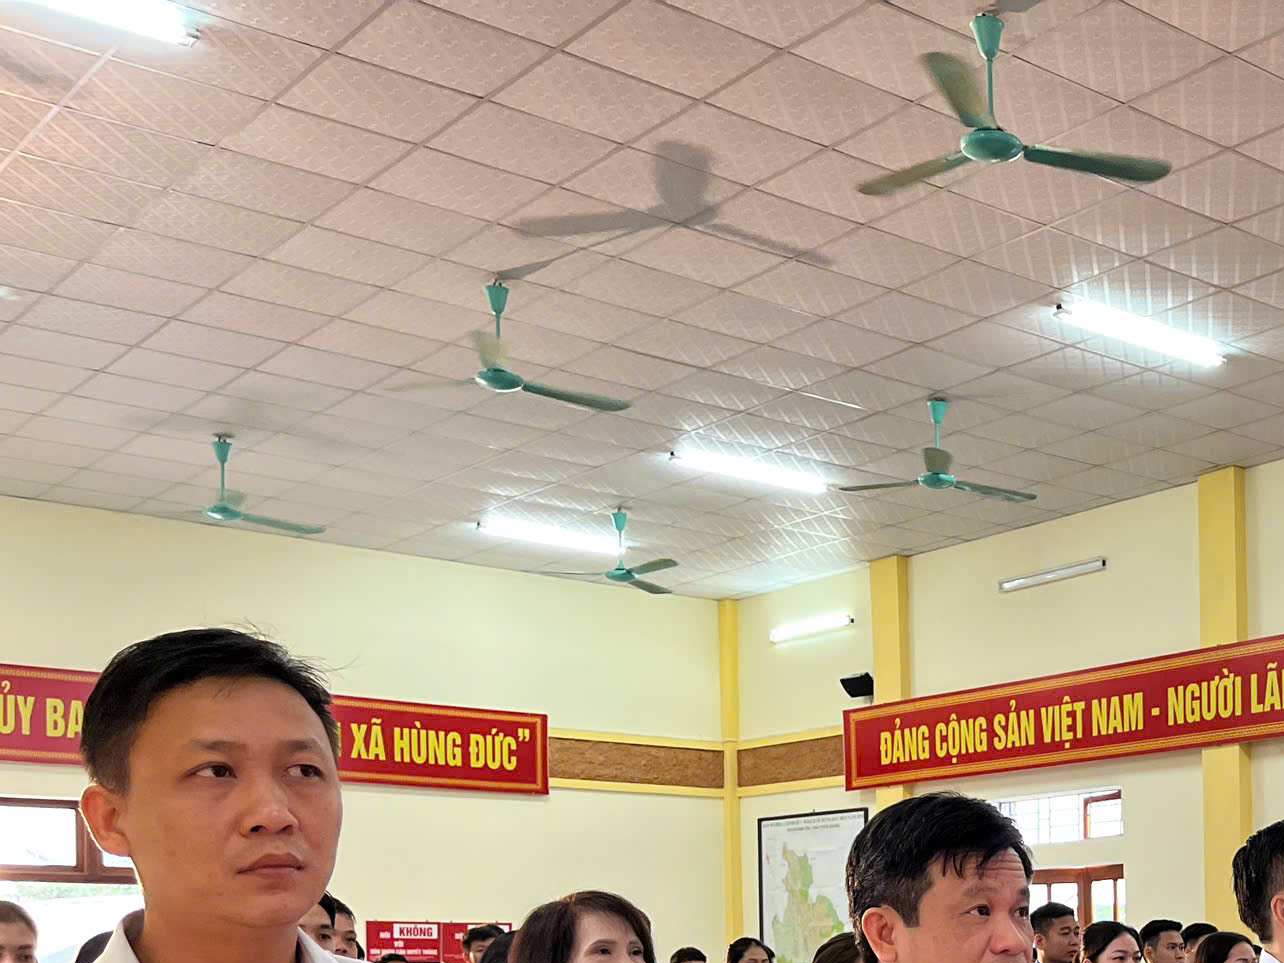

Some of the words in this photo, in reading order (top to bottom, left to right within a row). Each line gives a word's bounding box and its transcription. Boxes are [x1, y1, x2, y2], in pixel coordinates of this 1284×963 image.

[0, 680, 35, 735] ỦY
[46, 697, 84, 738] BA
[350, 718, 386, 761] XÃ
[393, 721, 462, 767] HÙNG
[879, 717, 930, 765] ĐẢNG
[934, 712, 988, 765] CỘNG
[993, 699, 1035, 753] SẢN
[1040, 695, 1086, 749] VIỆT
[1091, 692, 1144, 737] NAM
[1168, 668, 1243, 726] NGƯỜI
[399, 924, 433, 937] KHÔNG
